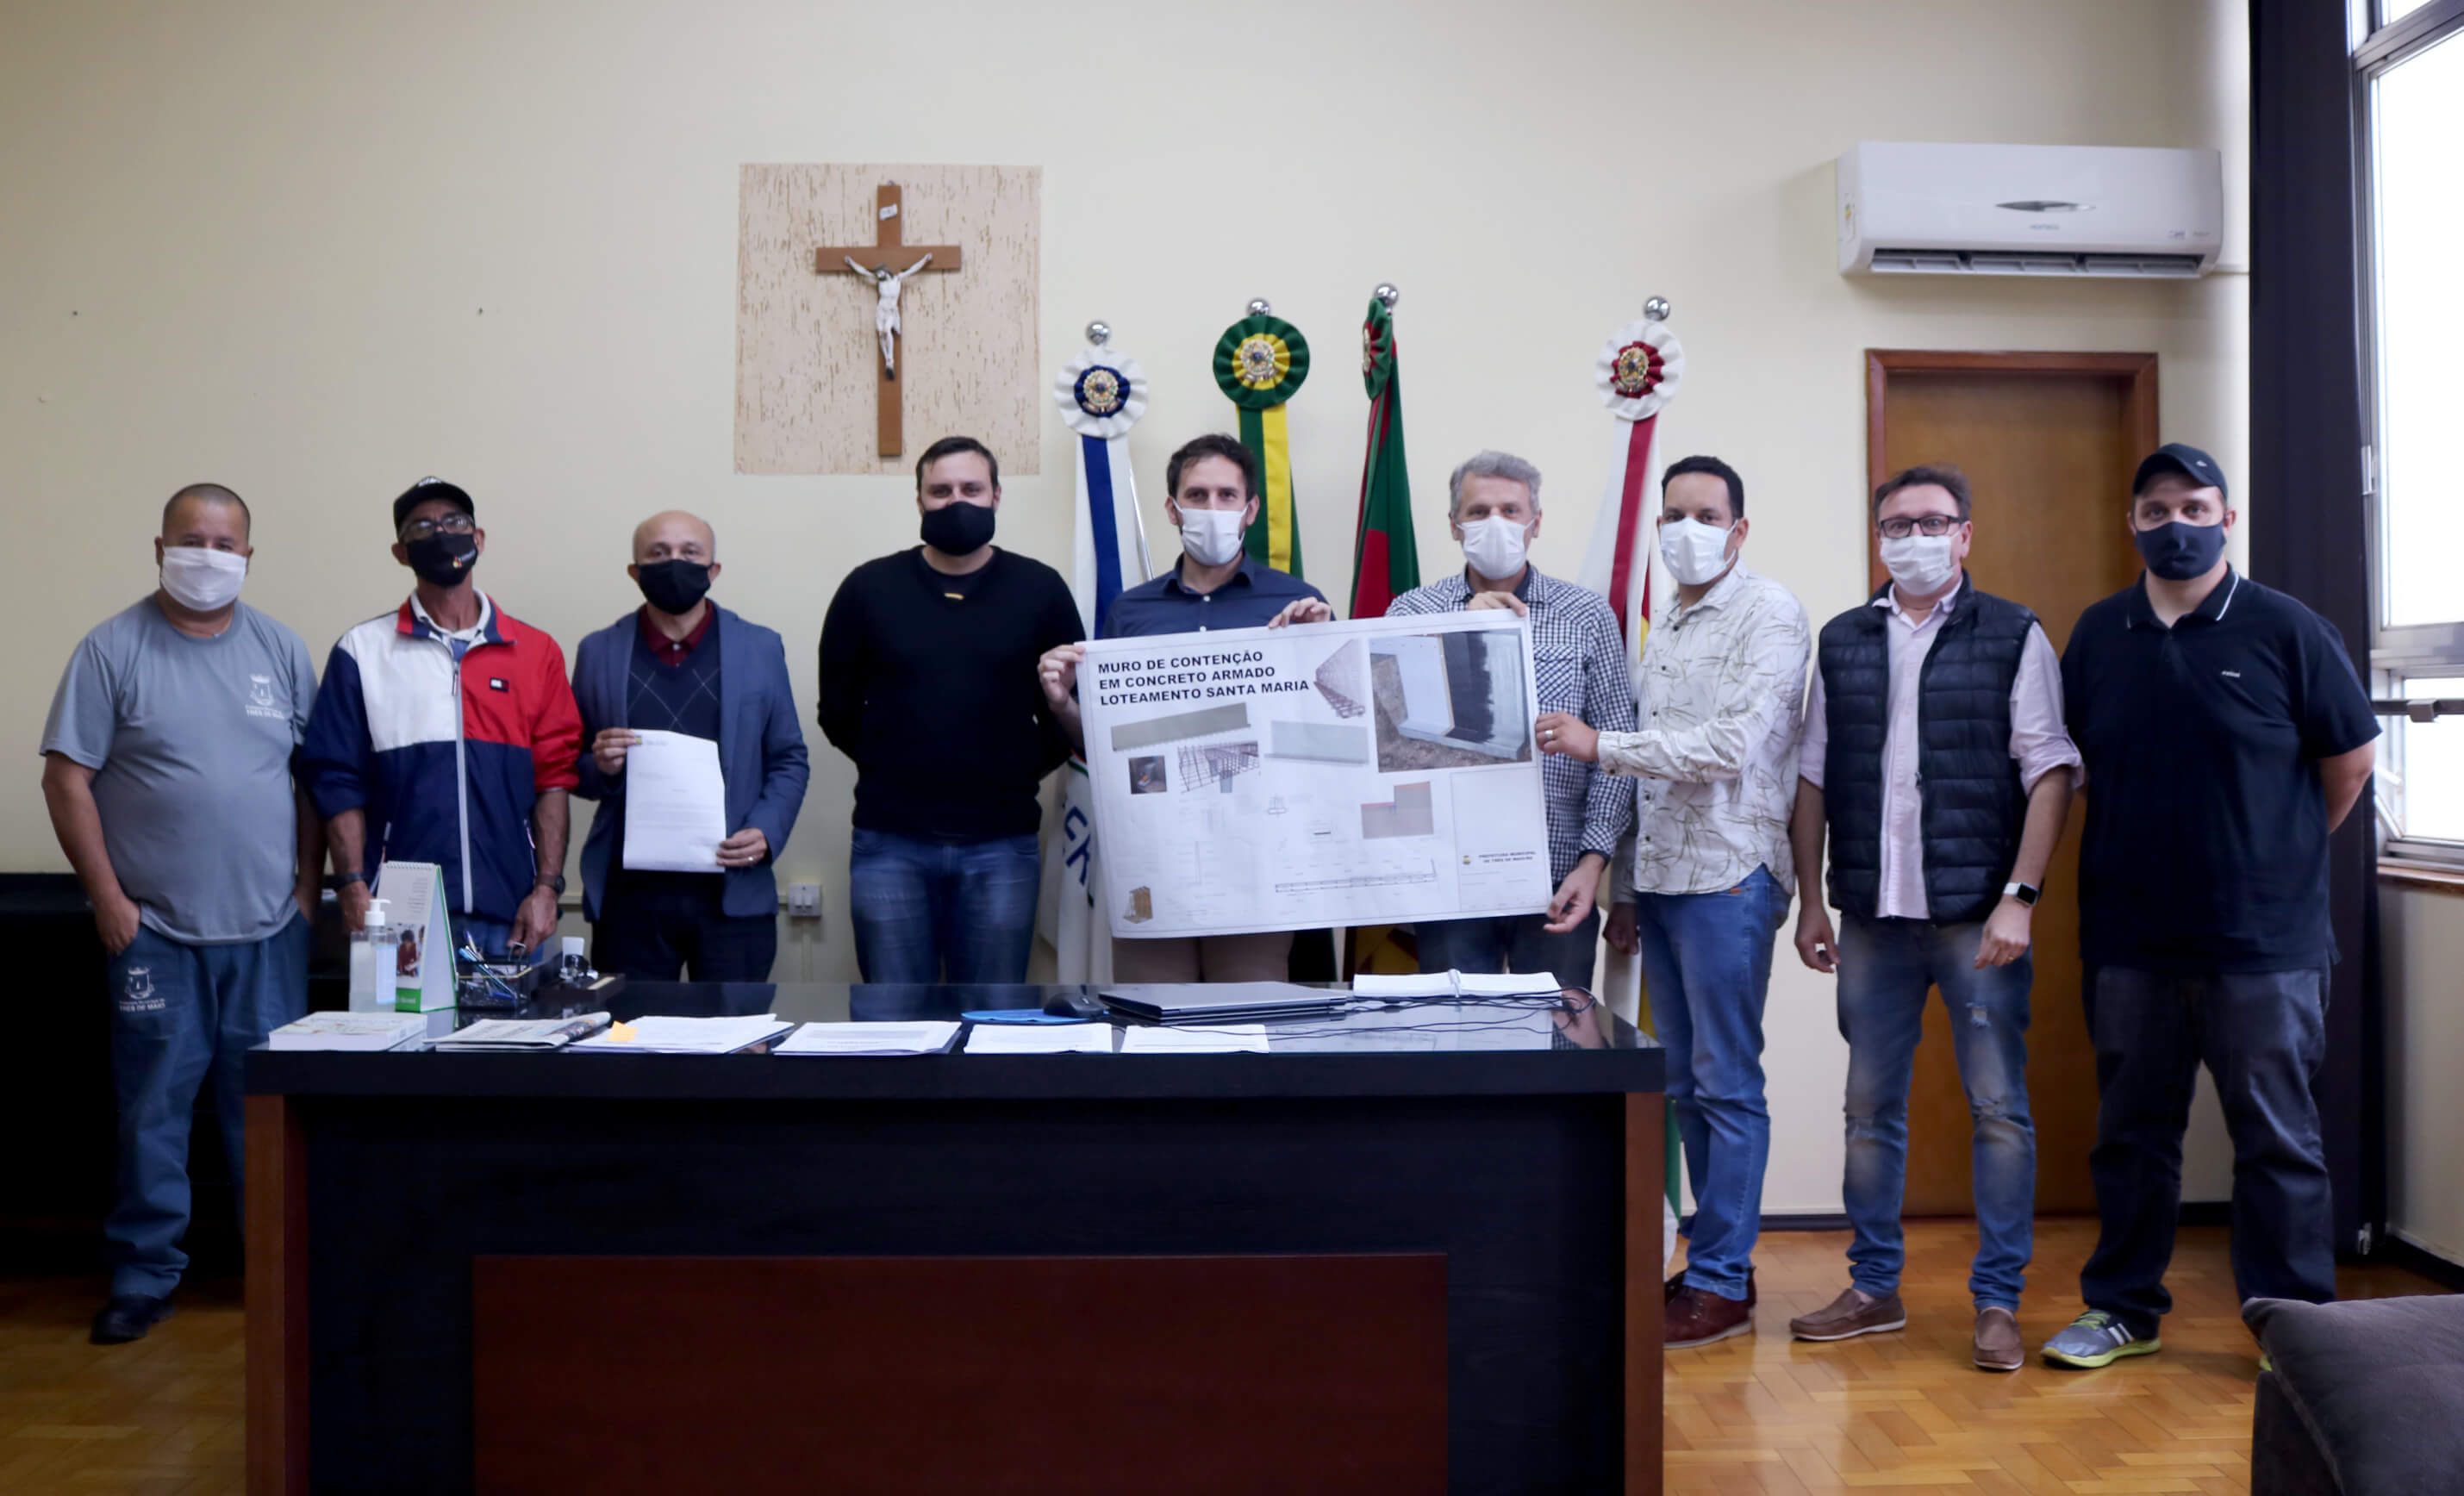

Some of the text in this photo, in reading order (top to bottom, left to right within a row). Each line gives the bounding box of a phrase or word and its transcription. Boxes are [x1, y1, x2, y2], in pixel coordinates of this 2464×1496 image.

[1097, 649, 1263, 674] MURO DE CONTENÇÃO
[1099, 666, 1276, 689] EM CONCRETO ARMADO
[1100, 679, 1310, 706] LOTEAMENTO SANTA MARIA
